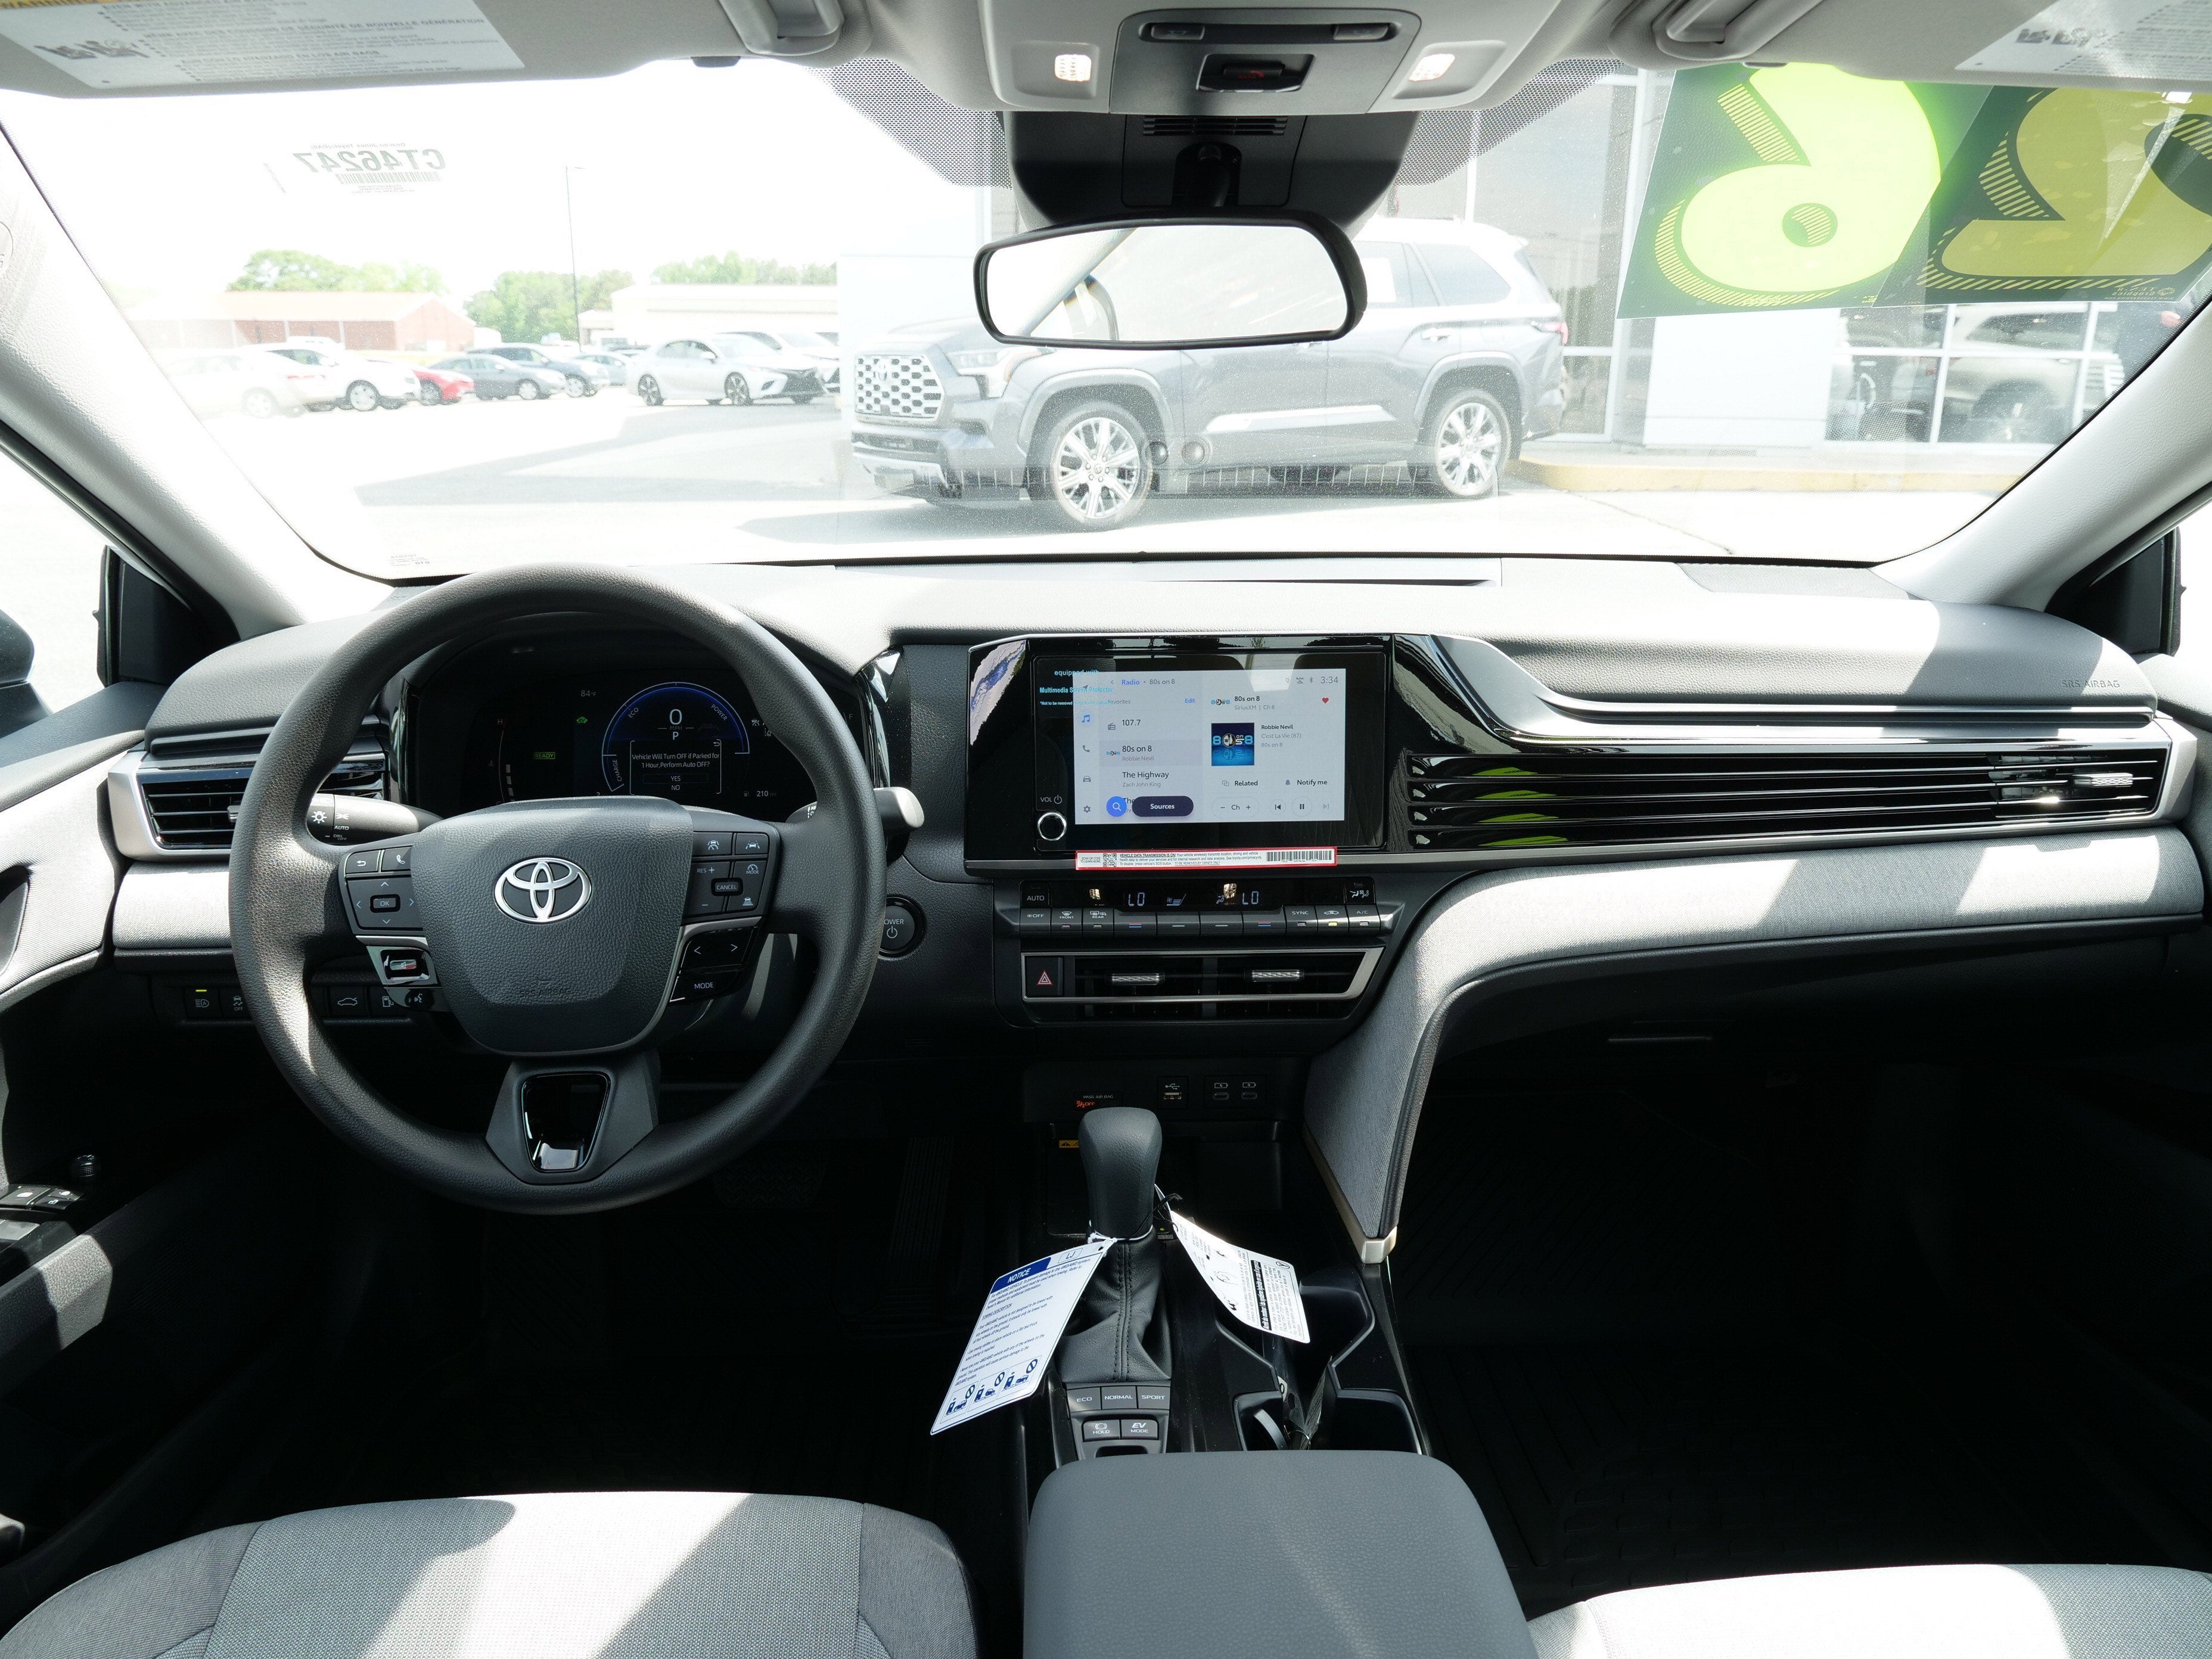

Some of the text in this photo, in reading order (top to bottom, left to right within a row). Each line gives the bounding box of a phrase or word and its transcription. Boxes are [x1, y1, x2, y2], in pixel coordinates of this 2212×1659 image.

[628, 707, 639, 718] ECO
[669, 709, 682, 726] 0
[711, 704, 727, 721] POWER
[613, 759, 622, 782] CHARGE
[1137, 771, 1169, 779] Highway
[1007, 1267, 1032, 1284] NOTICE
